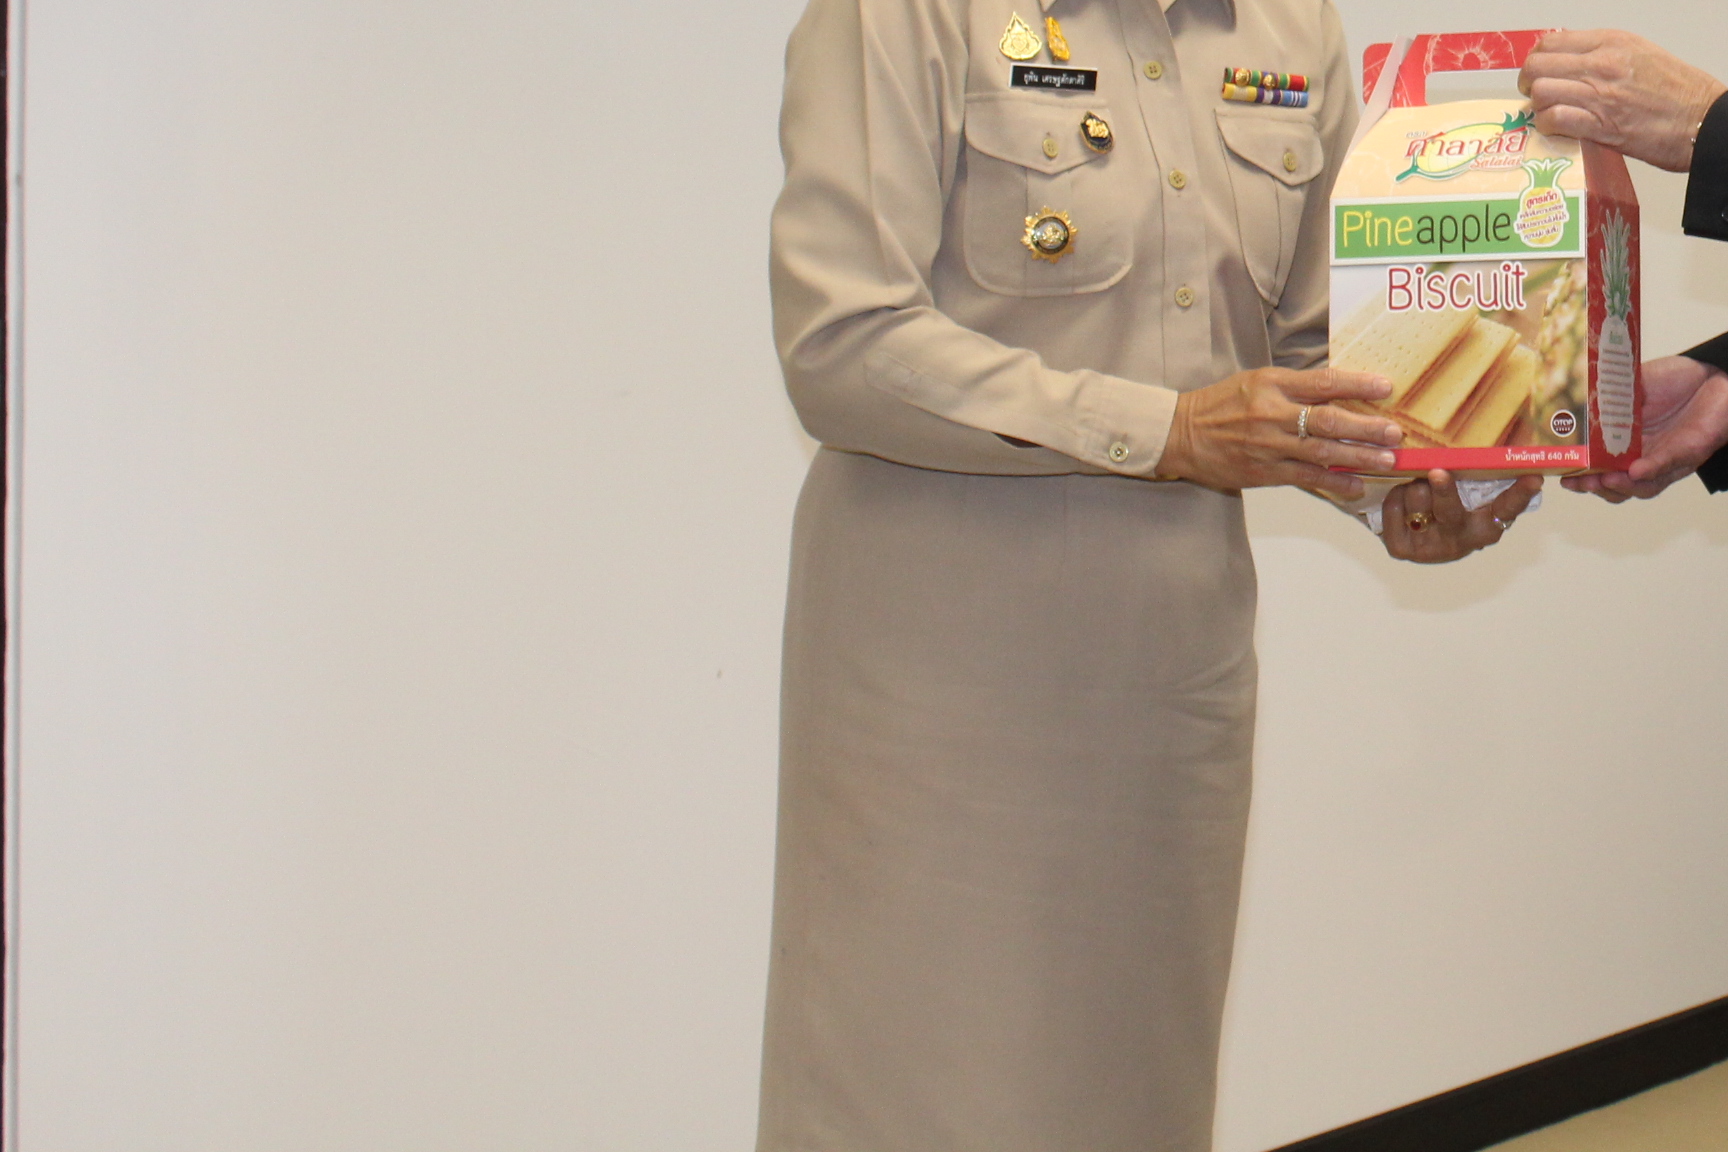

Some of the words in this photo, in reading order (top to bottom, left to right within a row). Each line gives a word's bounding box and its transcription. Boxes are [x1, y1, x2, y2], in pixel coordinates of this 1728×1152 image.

[1470, 155, 1522, 169] Salalai
[1342, 203, 1512, 253] Pineapple
[1387, 263, 1526, 311] Biscuit
[1553, 418, 1573, 427] OTOP
[1547, 452, 1562, 461] 640
[1564, 450, 1580, 461] กรัม
